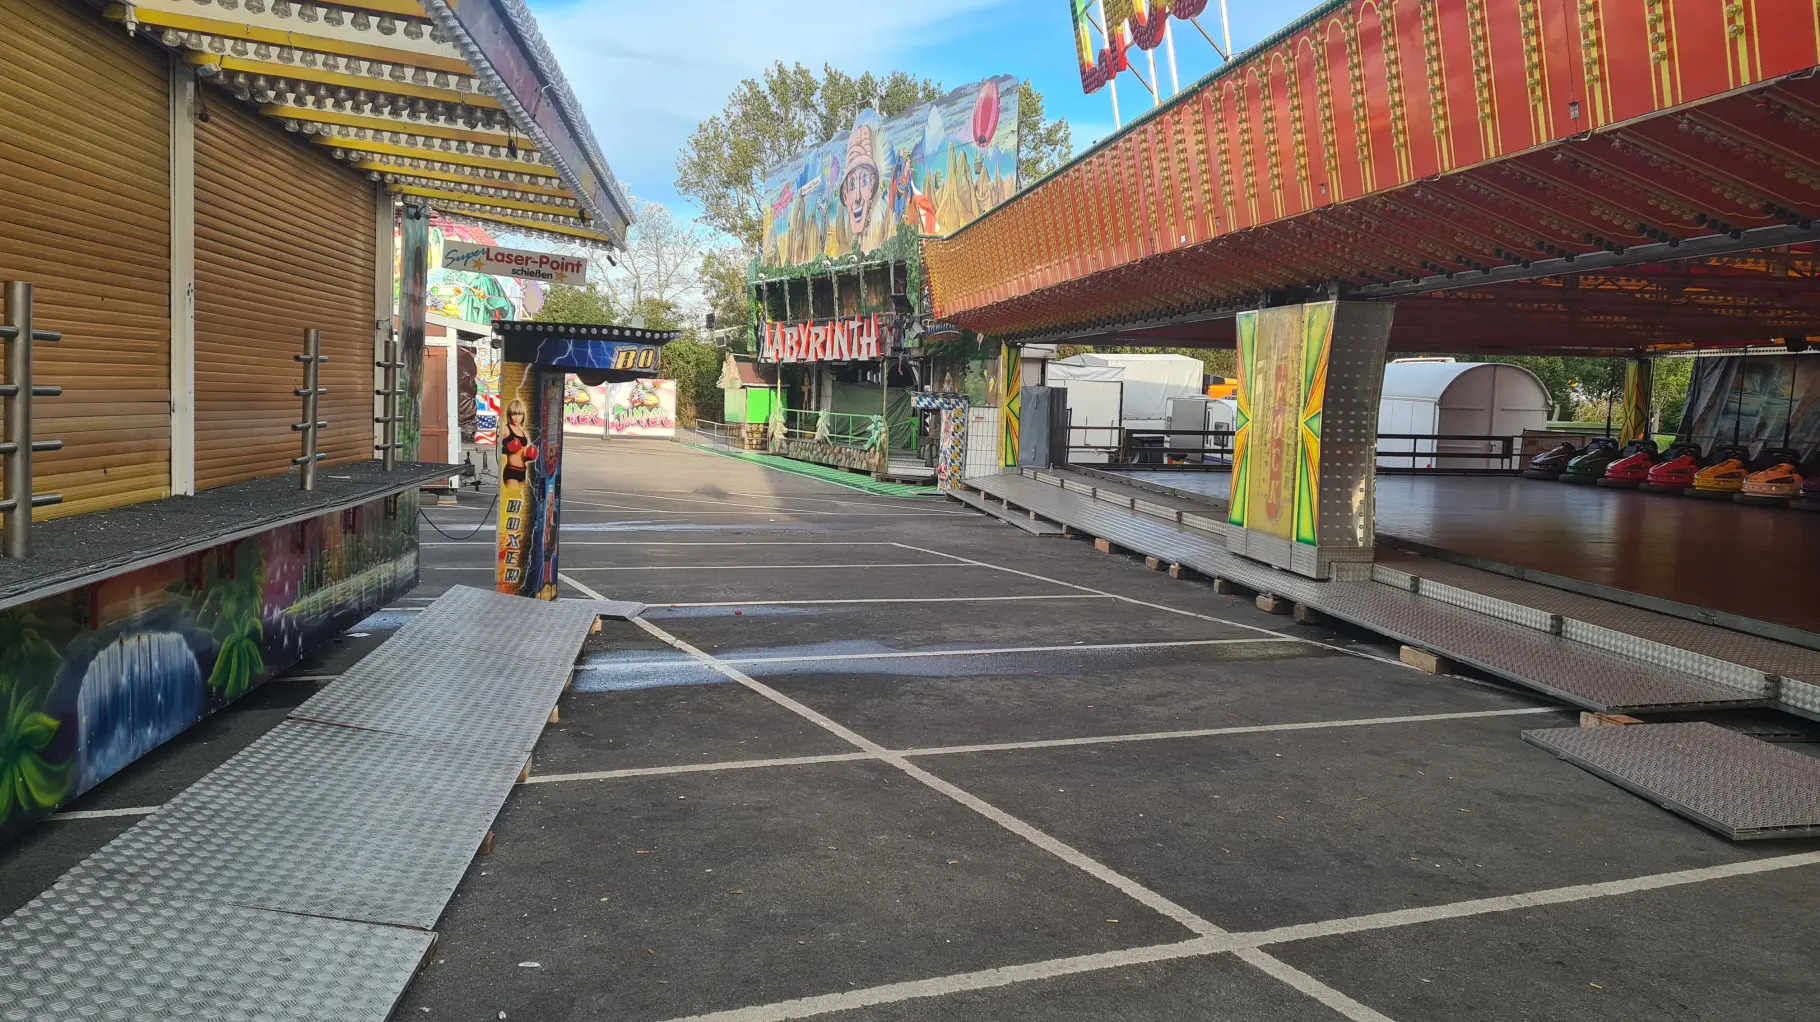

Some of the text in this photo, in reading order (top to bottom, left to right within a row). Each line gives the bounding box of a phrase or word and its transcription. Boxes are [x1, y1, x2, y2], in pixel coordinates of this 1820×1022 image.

[444, 247, 583, 274] Super Laser-Point
[511, 267, 553, 280] schießen
[761, 312, 881, 364] LABYRINTH
[614, 348, 660, 370] BO
[615, 404, 669, 433] JUMPER
[505, 499, 522, 582] BOXER
